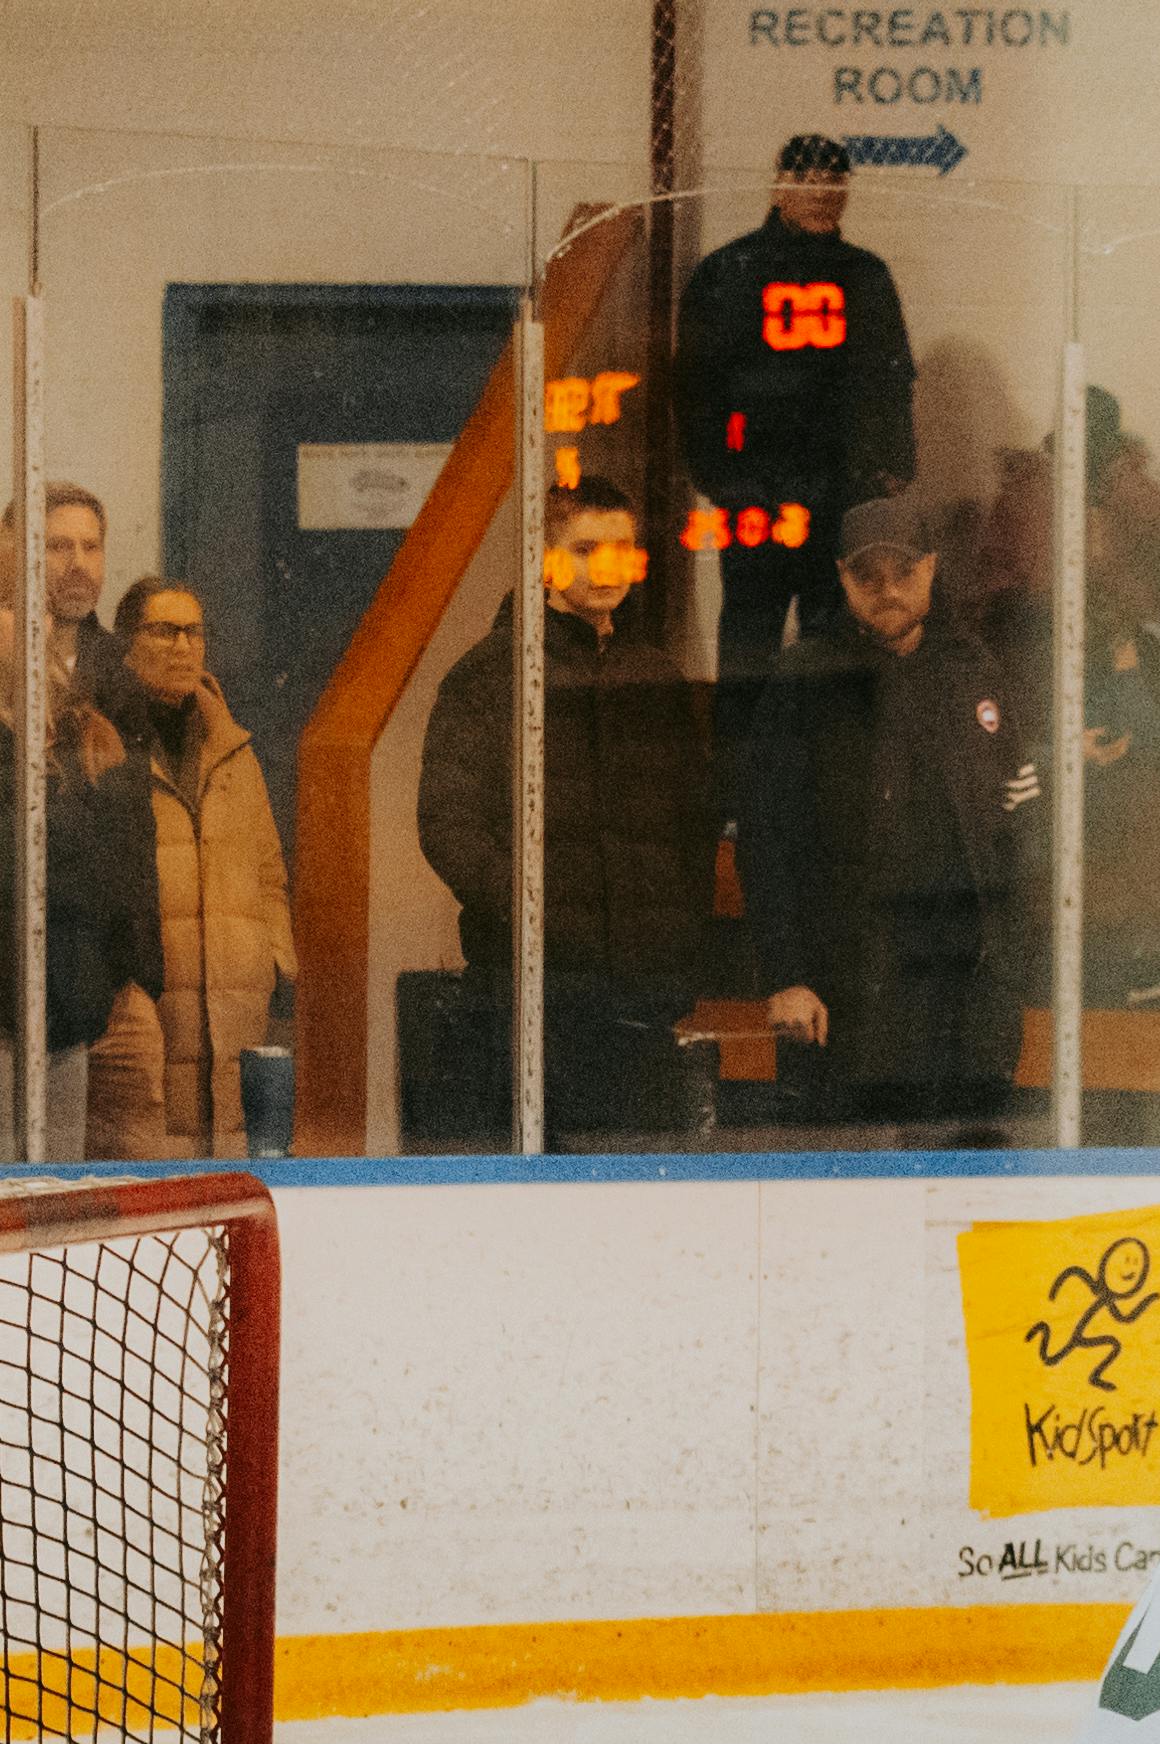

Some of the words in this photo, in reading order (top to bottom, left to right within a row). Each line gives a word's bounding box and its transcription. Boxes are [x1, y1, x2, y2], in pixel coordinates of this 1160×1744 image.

[748, 8, 1070, 47] RECREATION
[834, 66, 983, 105] ROOM
[1024, 1402, 1159, 1470] KidSport
[958, 1545, 992, 1578] So
[999, 1539, 1048, 1576] ALL
[1055, 1545, 1107, 1574] Kids
